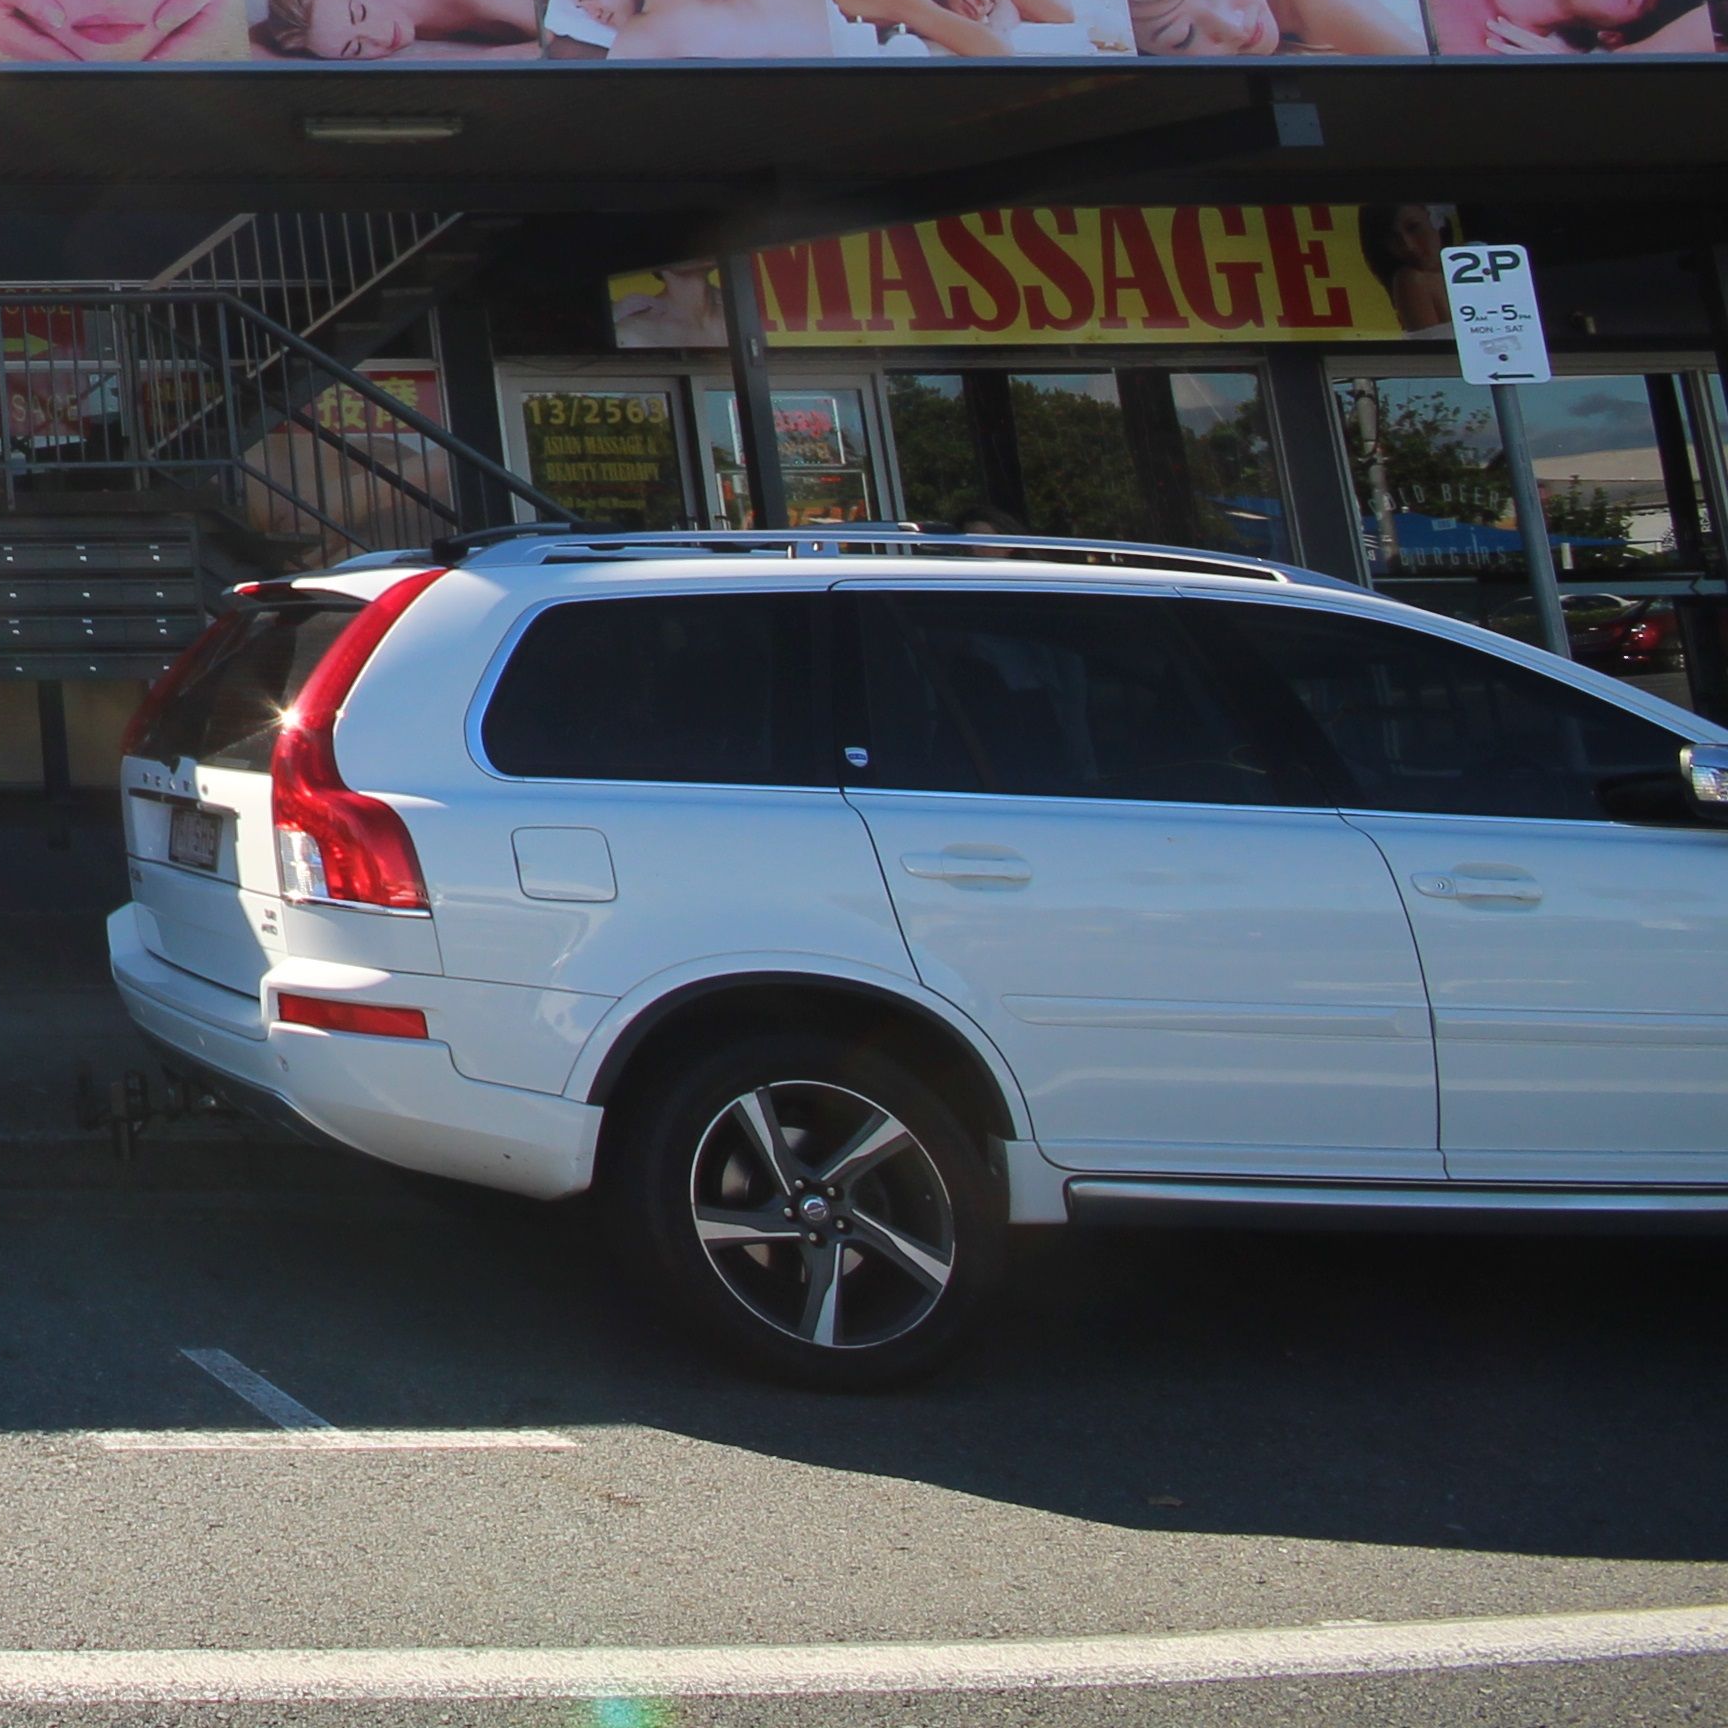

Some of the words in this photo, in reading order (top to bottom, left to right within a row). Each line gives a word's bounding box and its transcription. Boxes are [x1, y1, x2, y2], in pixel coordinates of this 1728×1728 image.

[749, 204, 1354, 333] MASSAGE
[1448, 250, 1521, 284] 2P
[529, 398, 664, 426] 13/2563
